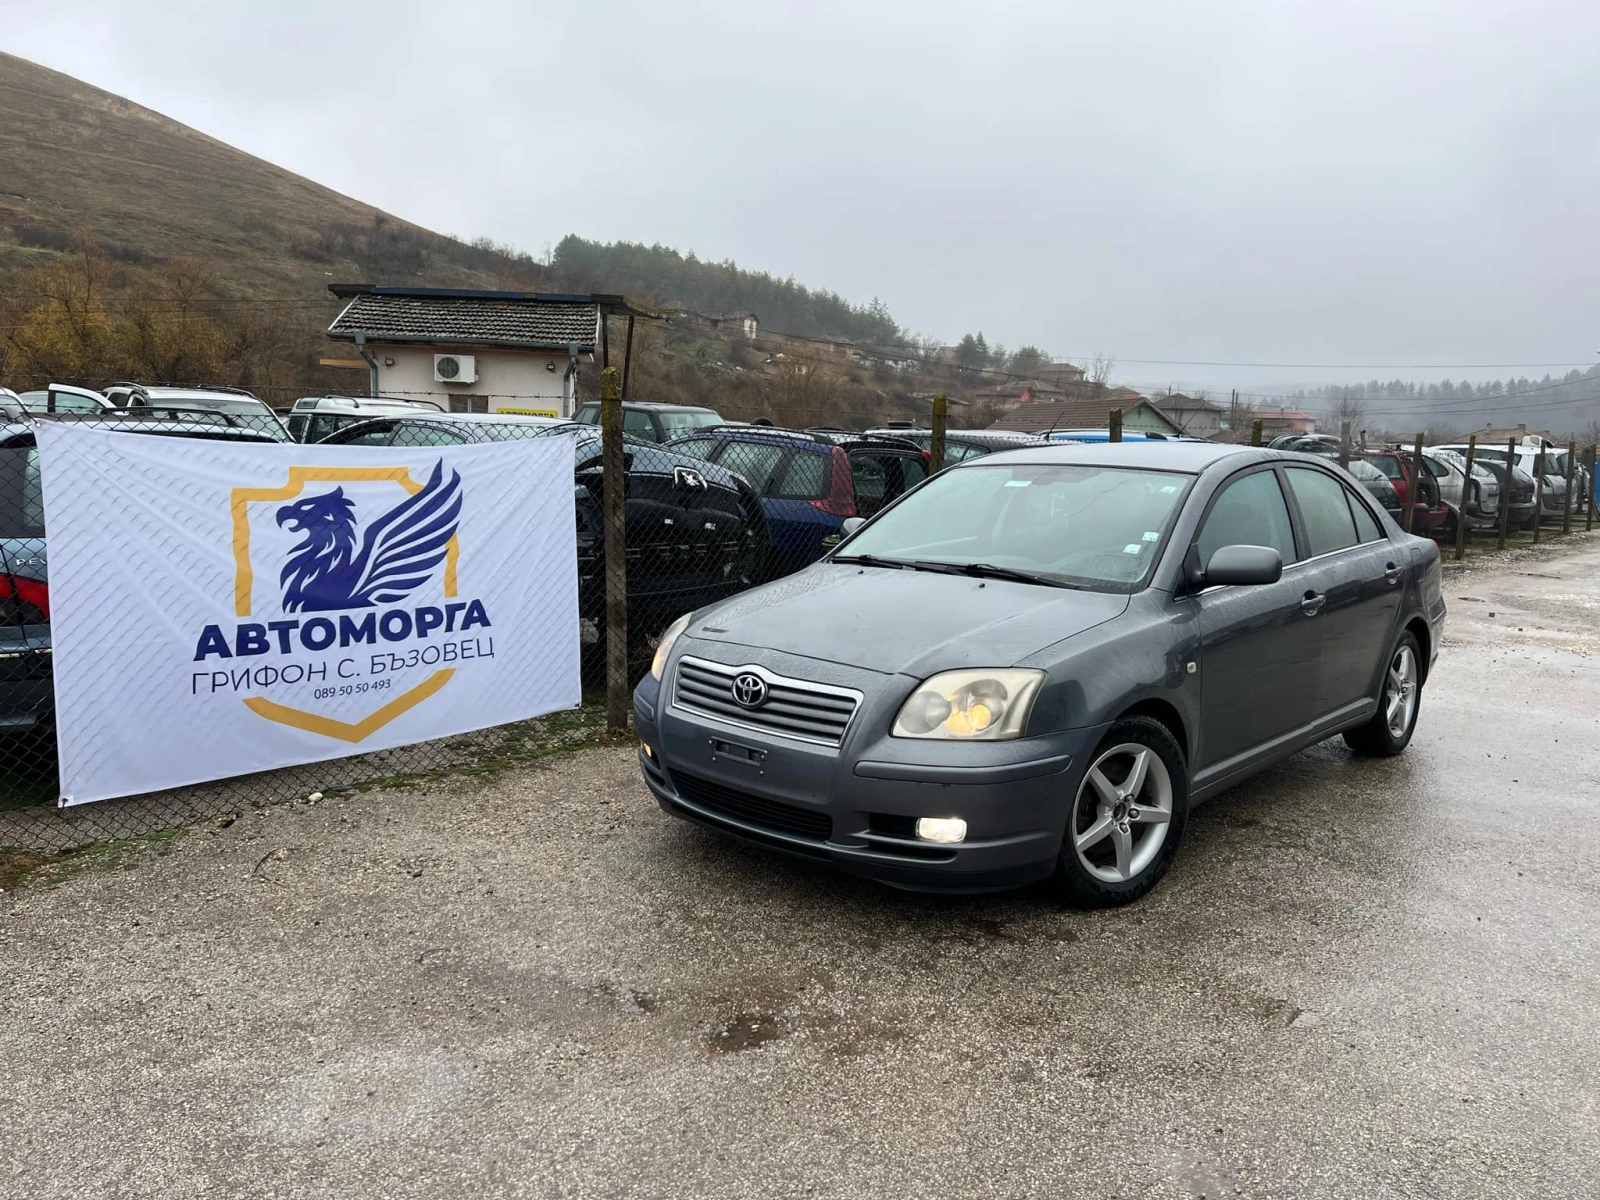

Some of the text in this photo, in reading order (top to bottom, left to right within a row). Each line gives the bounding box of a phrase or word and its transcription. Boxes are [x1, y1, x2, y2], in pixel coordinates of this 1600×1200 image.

[193, 599, 492, 661] АВТОМОРГА
[192, 637, 495, 694] ГРИФОН С. БЪЗОВЕЦ
[314, 679, 391, 699] 089 50 50 493
